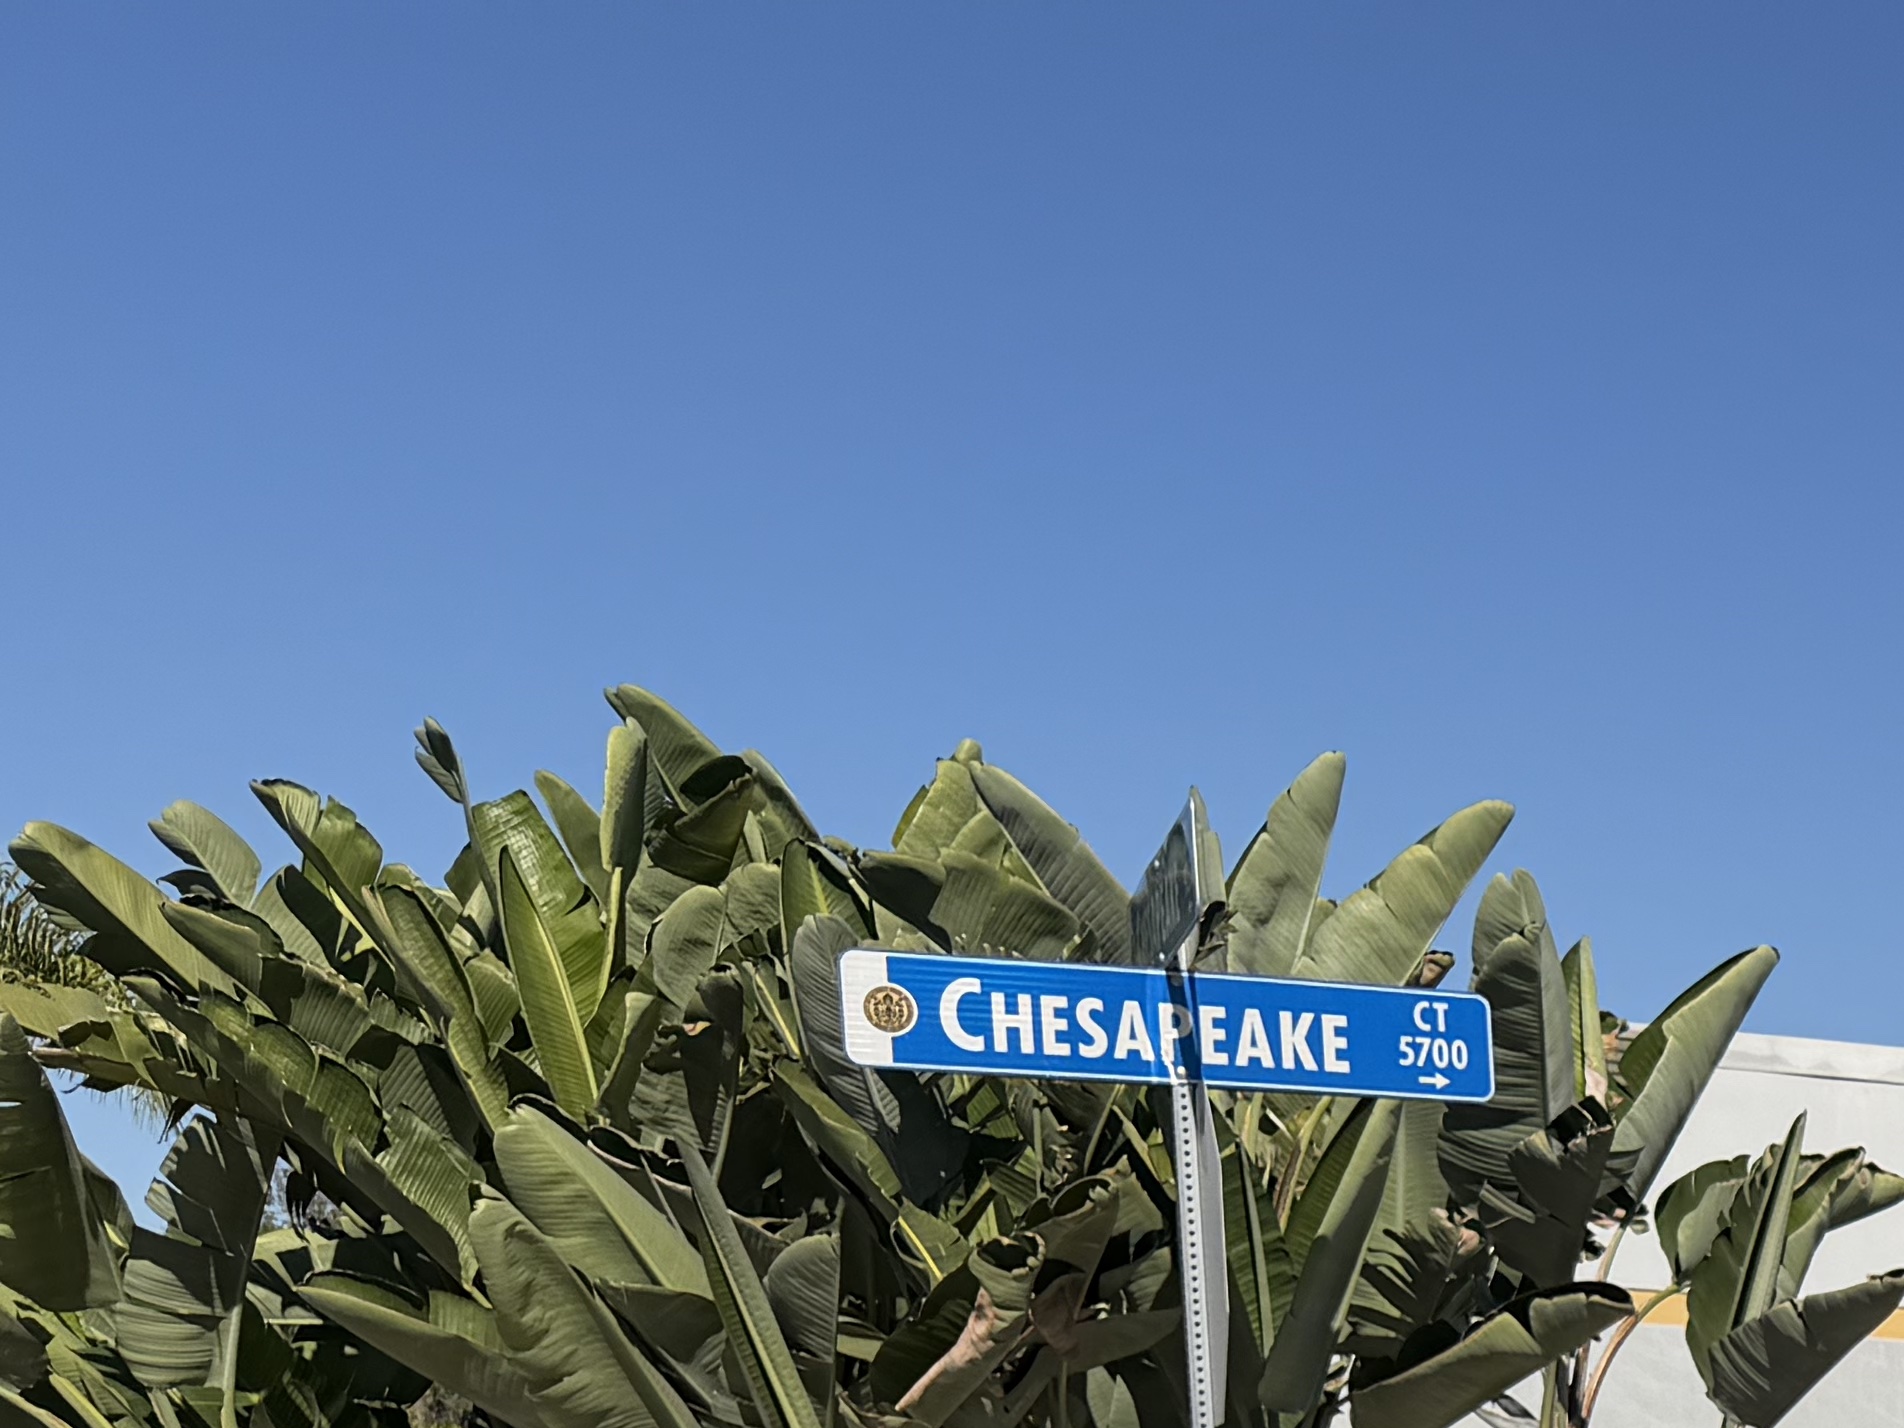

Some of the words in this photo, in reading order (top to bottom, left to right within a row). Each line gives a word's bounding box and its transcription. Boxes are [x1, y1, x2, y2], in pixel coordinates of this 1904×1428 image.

[940, 976, 1350, 1074] CHESAPEAKE
[1413, 1000, 1447, 1032] CT
[1398, 1037, 1469, 1072] 5700
